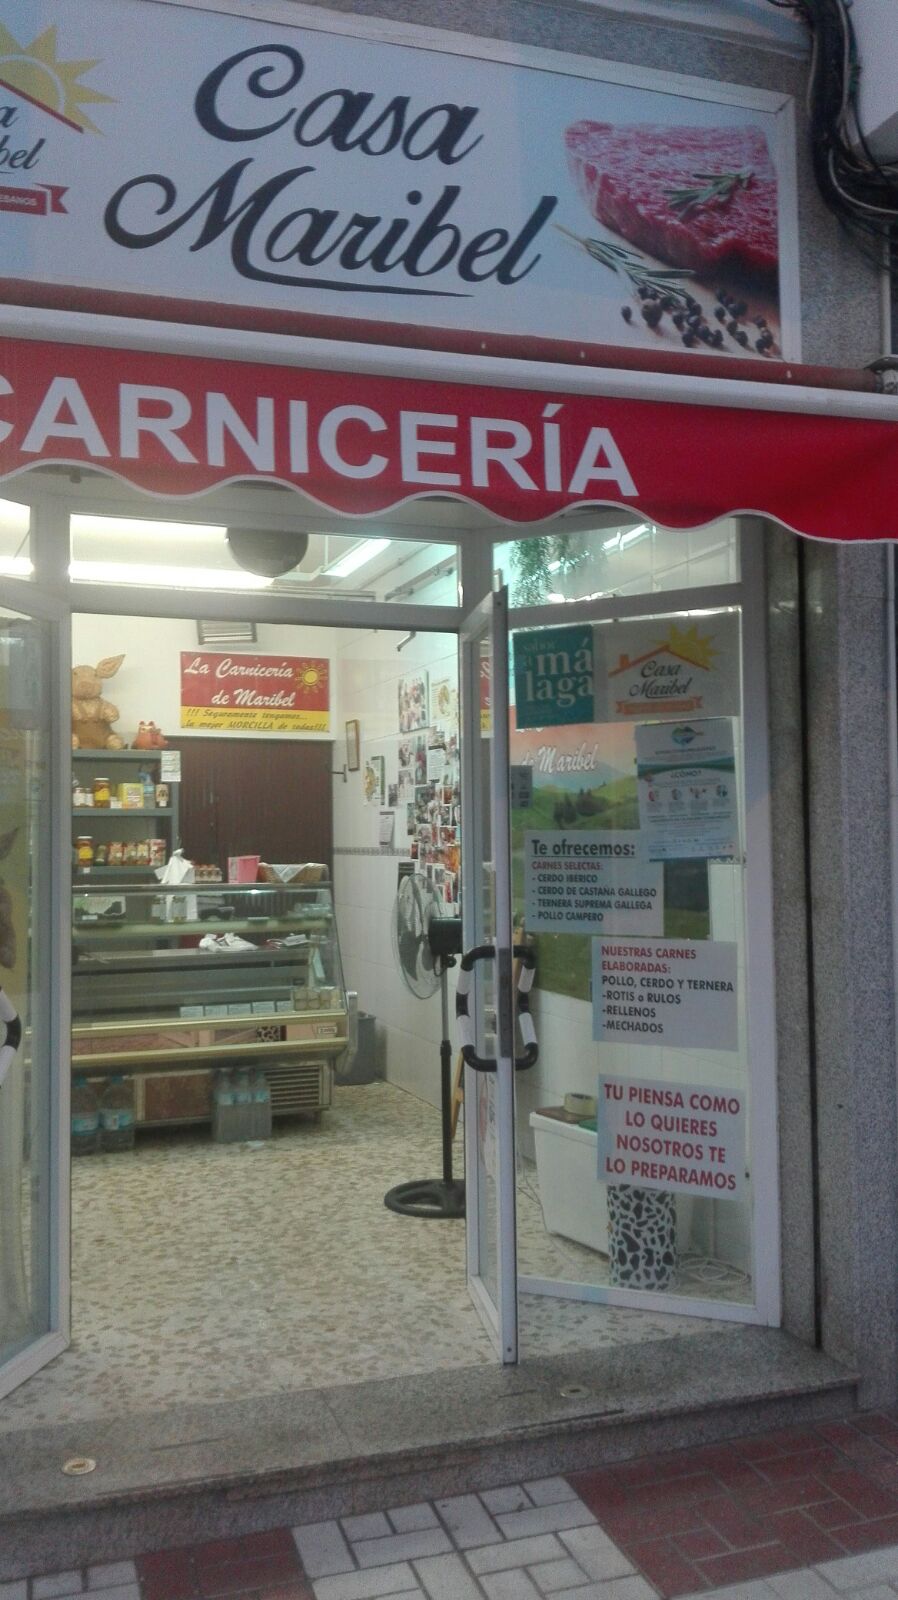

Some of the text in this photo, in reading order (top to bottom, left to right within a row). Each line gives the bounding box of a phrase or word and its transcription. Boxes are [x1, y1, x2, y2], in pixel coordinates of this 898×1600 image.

[195, 43, 484, 165] Casa
[104, 157, 558, 297] Maribel
[0, 371, 639, 496] ARNICERÍA
[184, 657, 294, 678] La Carnicería
[640, 660, 682, 679] Casa
[629, 677, 693, 698] Maribel
[211, 688, 296, 707] de Maribel
[228, 720, 273, 730] MORCILLA
[538, 742, 599, 773] Maribel
[532, 839, 547, 856] Te
[552, 838, 635, 856] ofrecemos:
[532, 861, 561, 870] CARNES
[537, 874, 563, 883] CERDO
[538, 886, 564, 895] CERDO
[566, 887, 576, 895] DE
[618, 888, 656, 897] GALLEGO
[538, 899, 572, 908] TERNERA
[574, 900, 612, 909] SUPREMA
[615, 900, 653, 910] GALLEGA
[538, 911, 564, 921] POLLO
[566, 912, 604, 922] CAMPERO
[602, 946, 697, 960] NUESTRAS CARNES
[602, 961, 671, 974] ELABORADAS:
[602, 975, 734, 992] POLLO, CERDO Y TERNERA
[647, 992, 682, 1005] RULOS
[604, 1083, 741, 1115] TU PIENSA COMO
[626, 1110, 718, 1137] LO QUIERES
[616, 1134, 726, 1163] NOSOTROS TE
[606, 1157, 737, 1190] LO PREPARAMOS
